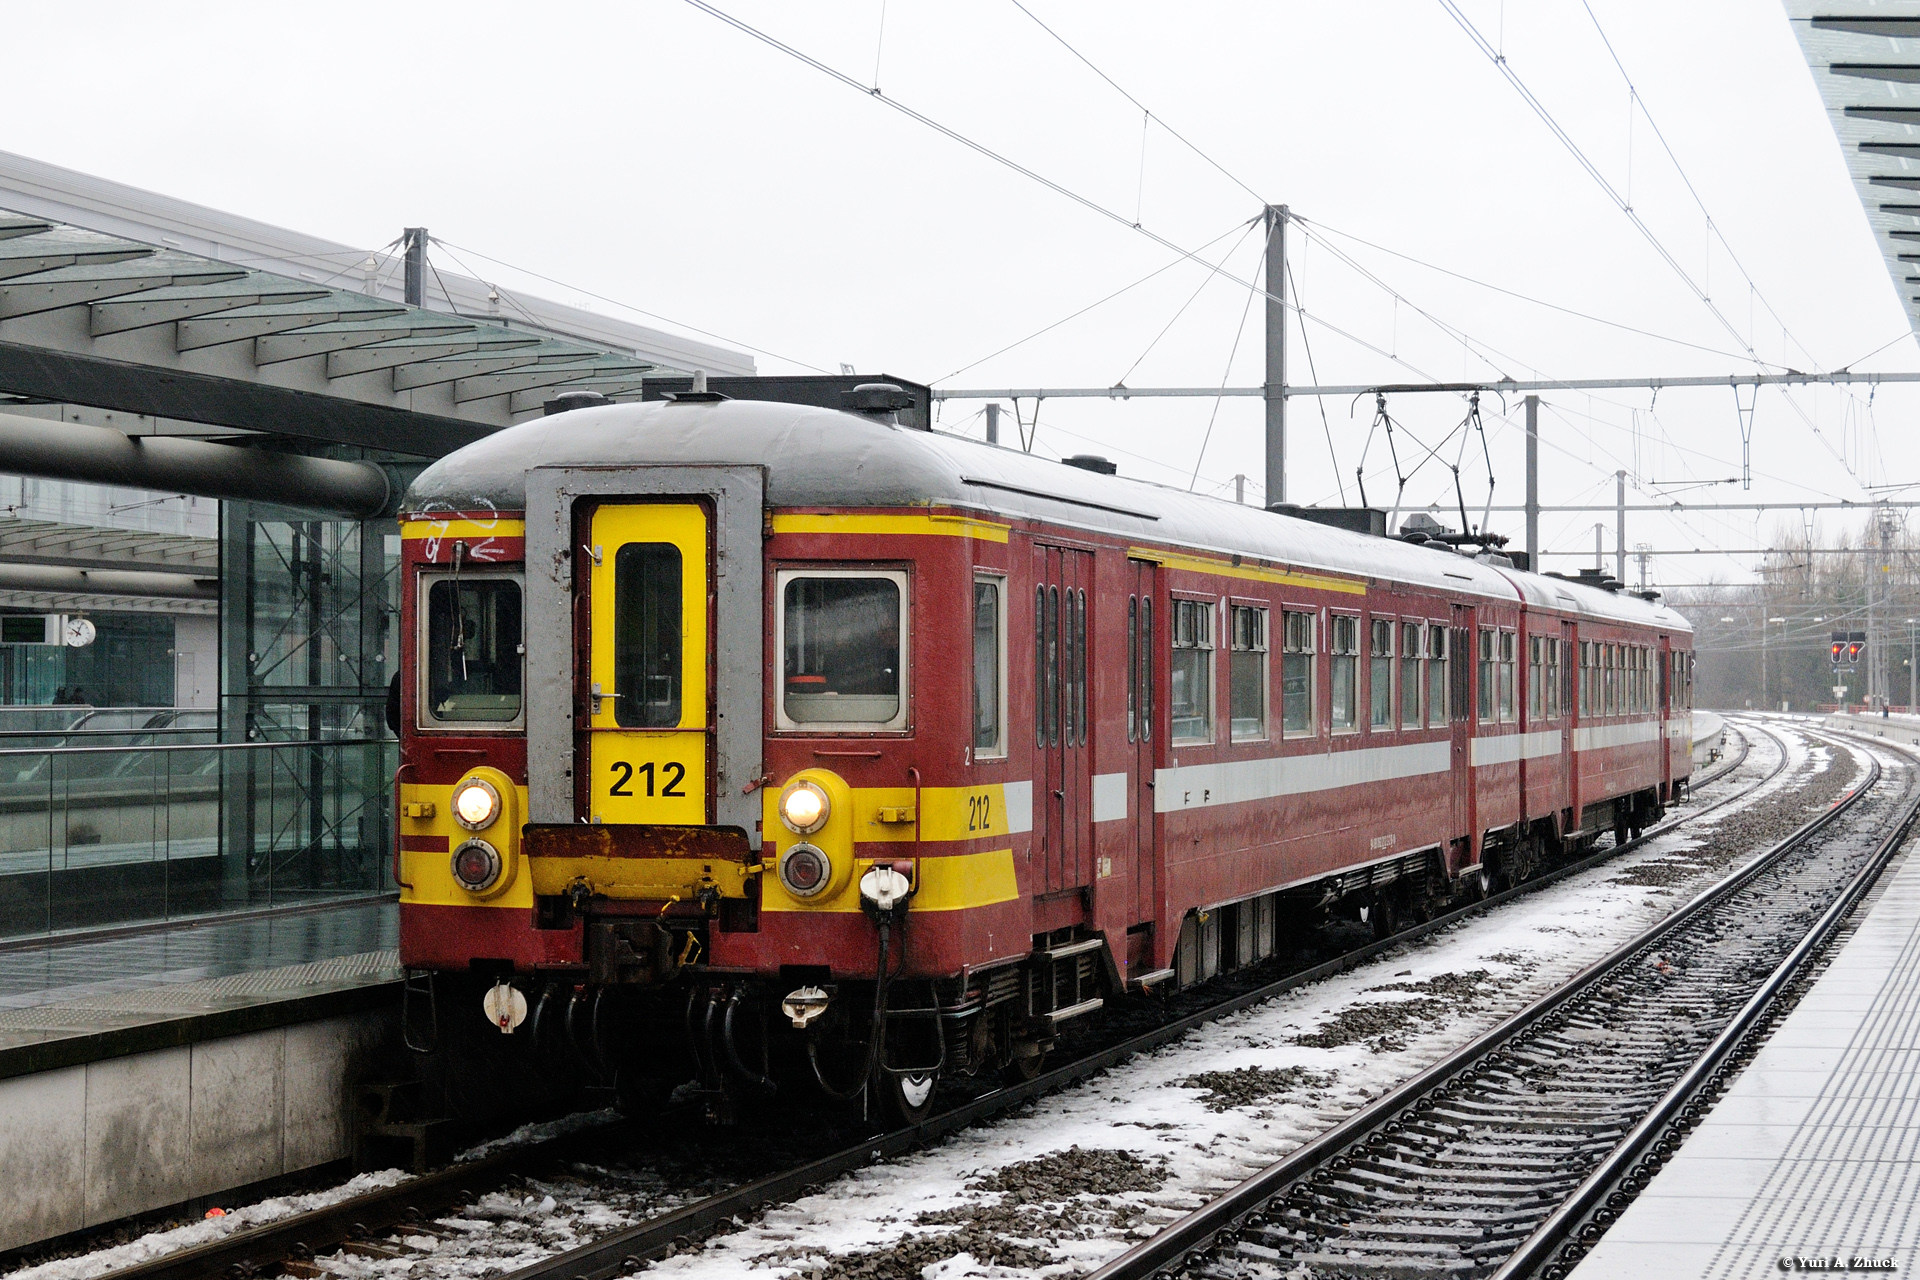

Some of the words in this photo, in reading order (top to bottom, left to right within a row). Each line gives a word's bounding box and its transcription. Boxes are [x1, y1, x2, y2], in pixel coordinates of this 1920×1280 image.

[1219, 596, 1226, 649] 1
[1320, 606, 1326, 653] 1
[964, 746, 970, 766] 2
[609, 761, 686, 797] 212
[969, 794, 990, 831] 212
